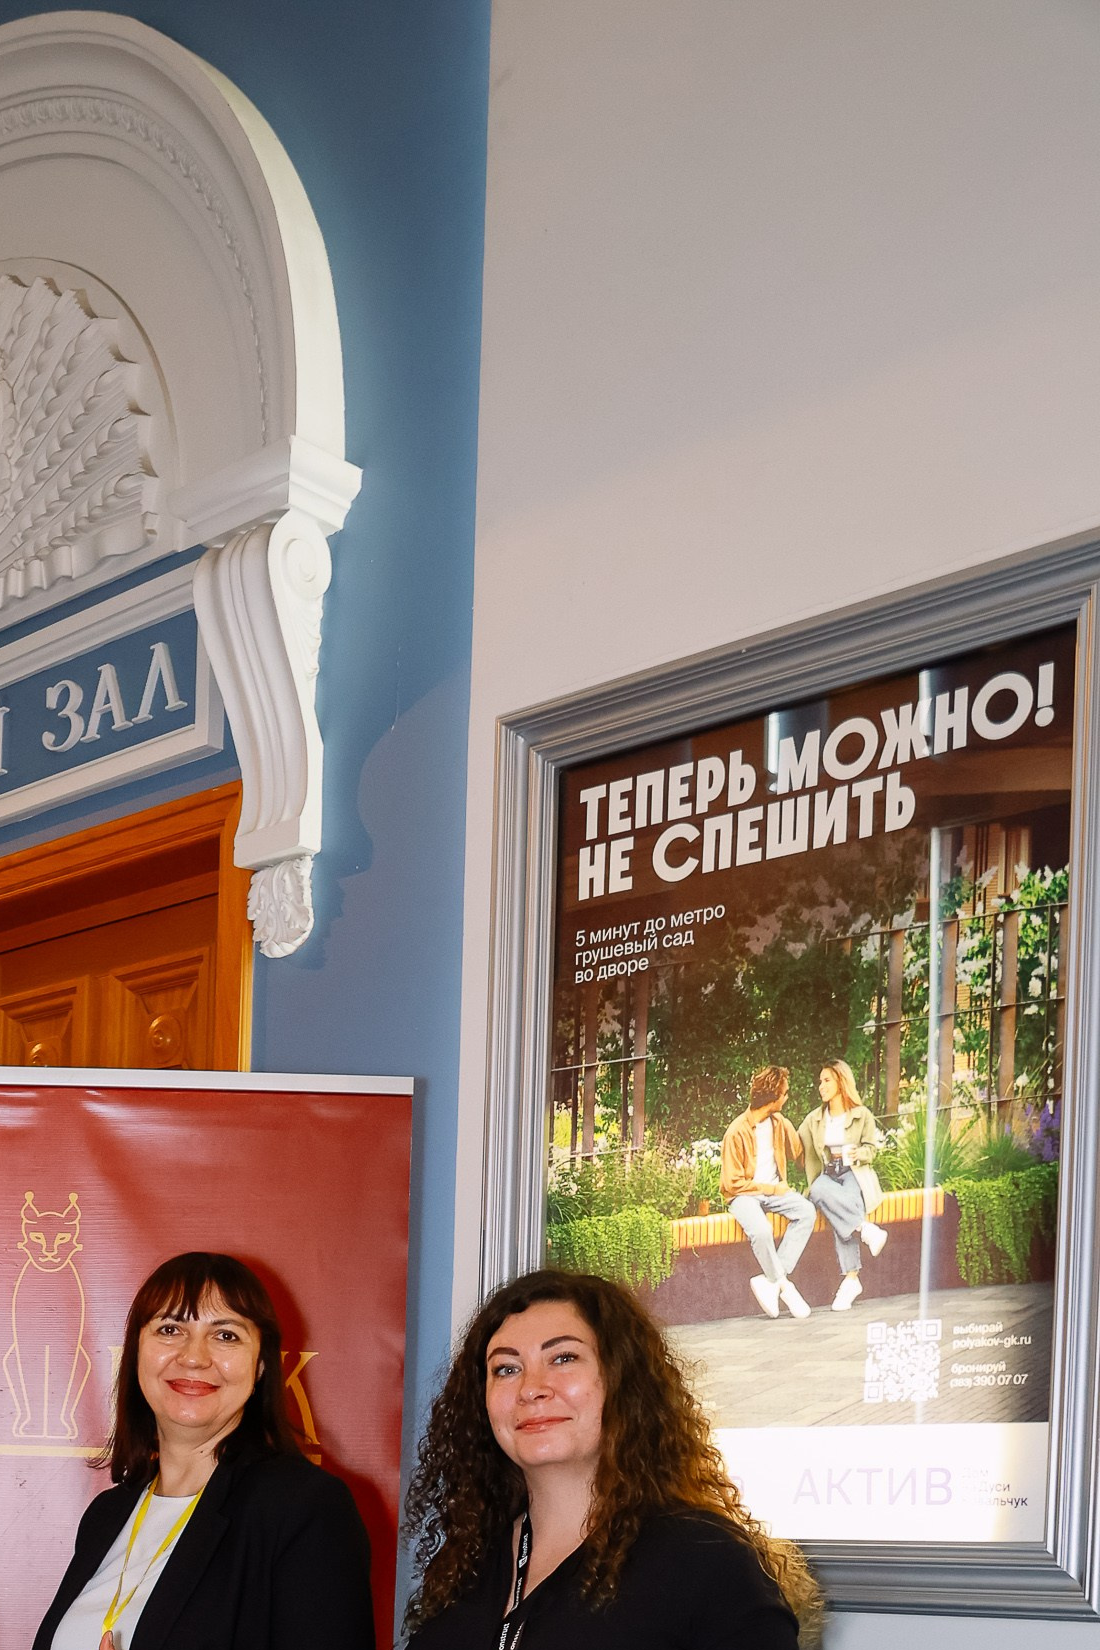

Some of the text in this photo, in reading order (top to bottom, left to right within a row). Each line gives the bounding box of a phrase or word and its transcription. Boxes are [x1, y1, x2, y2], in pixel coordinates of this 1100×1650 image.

[42, 642, 188, 753] ЗАЛ
[579, 661, 1056, 841] ТЕПЕРЬ МОЖНО!
[577, 771, 917, 901] НЕ СПЕШИТЬ
[575, 904, 726, 947] 5 минут до метро
[575, 930, 695, 967] грушевый сад
[575, 957, 650, 984] во дворе
[952, 1321, 1004, 1335] выбирай
[973, 1374, 996, 1387] 390
[997, 1374, 1013, 1386] 07
[1013, 1373, 1029, 1385] 07
[792, 1467, 953, 1506] АКТИВ
